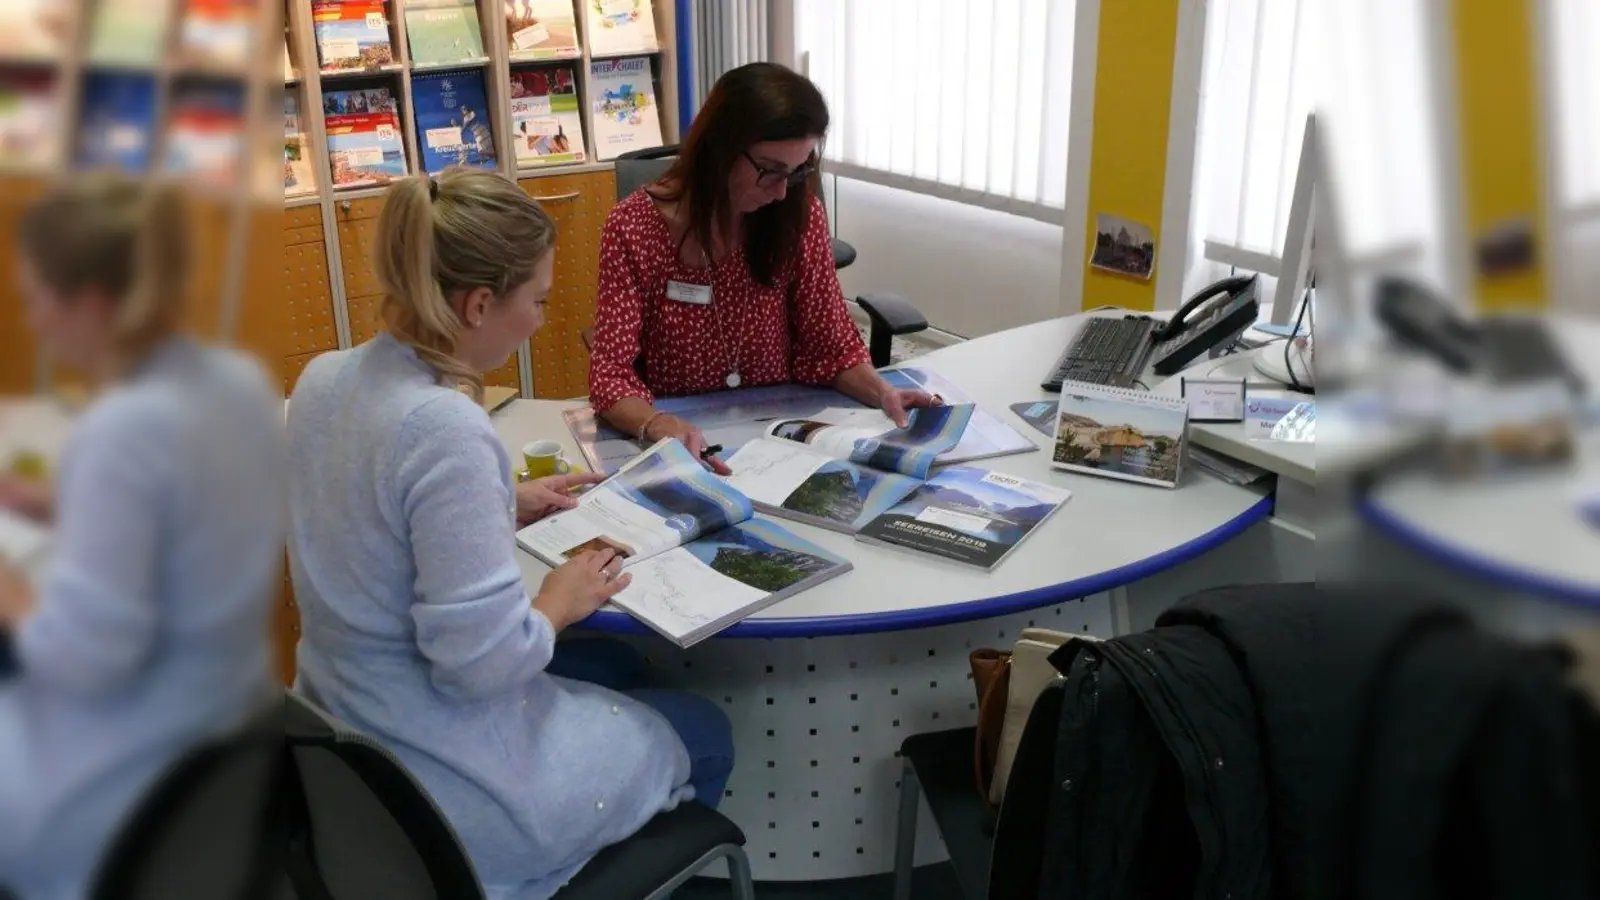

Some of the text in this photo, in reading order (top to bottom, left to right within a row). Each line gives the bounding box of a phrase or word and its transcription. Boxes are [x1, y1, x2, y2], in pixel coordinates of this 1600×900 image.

[618, 60, 644, 72] CHALET
[893, 520, 957, 540] SEEREISEN
[957, 535, 988, 549] 2019
